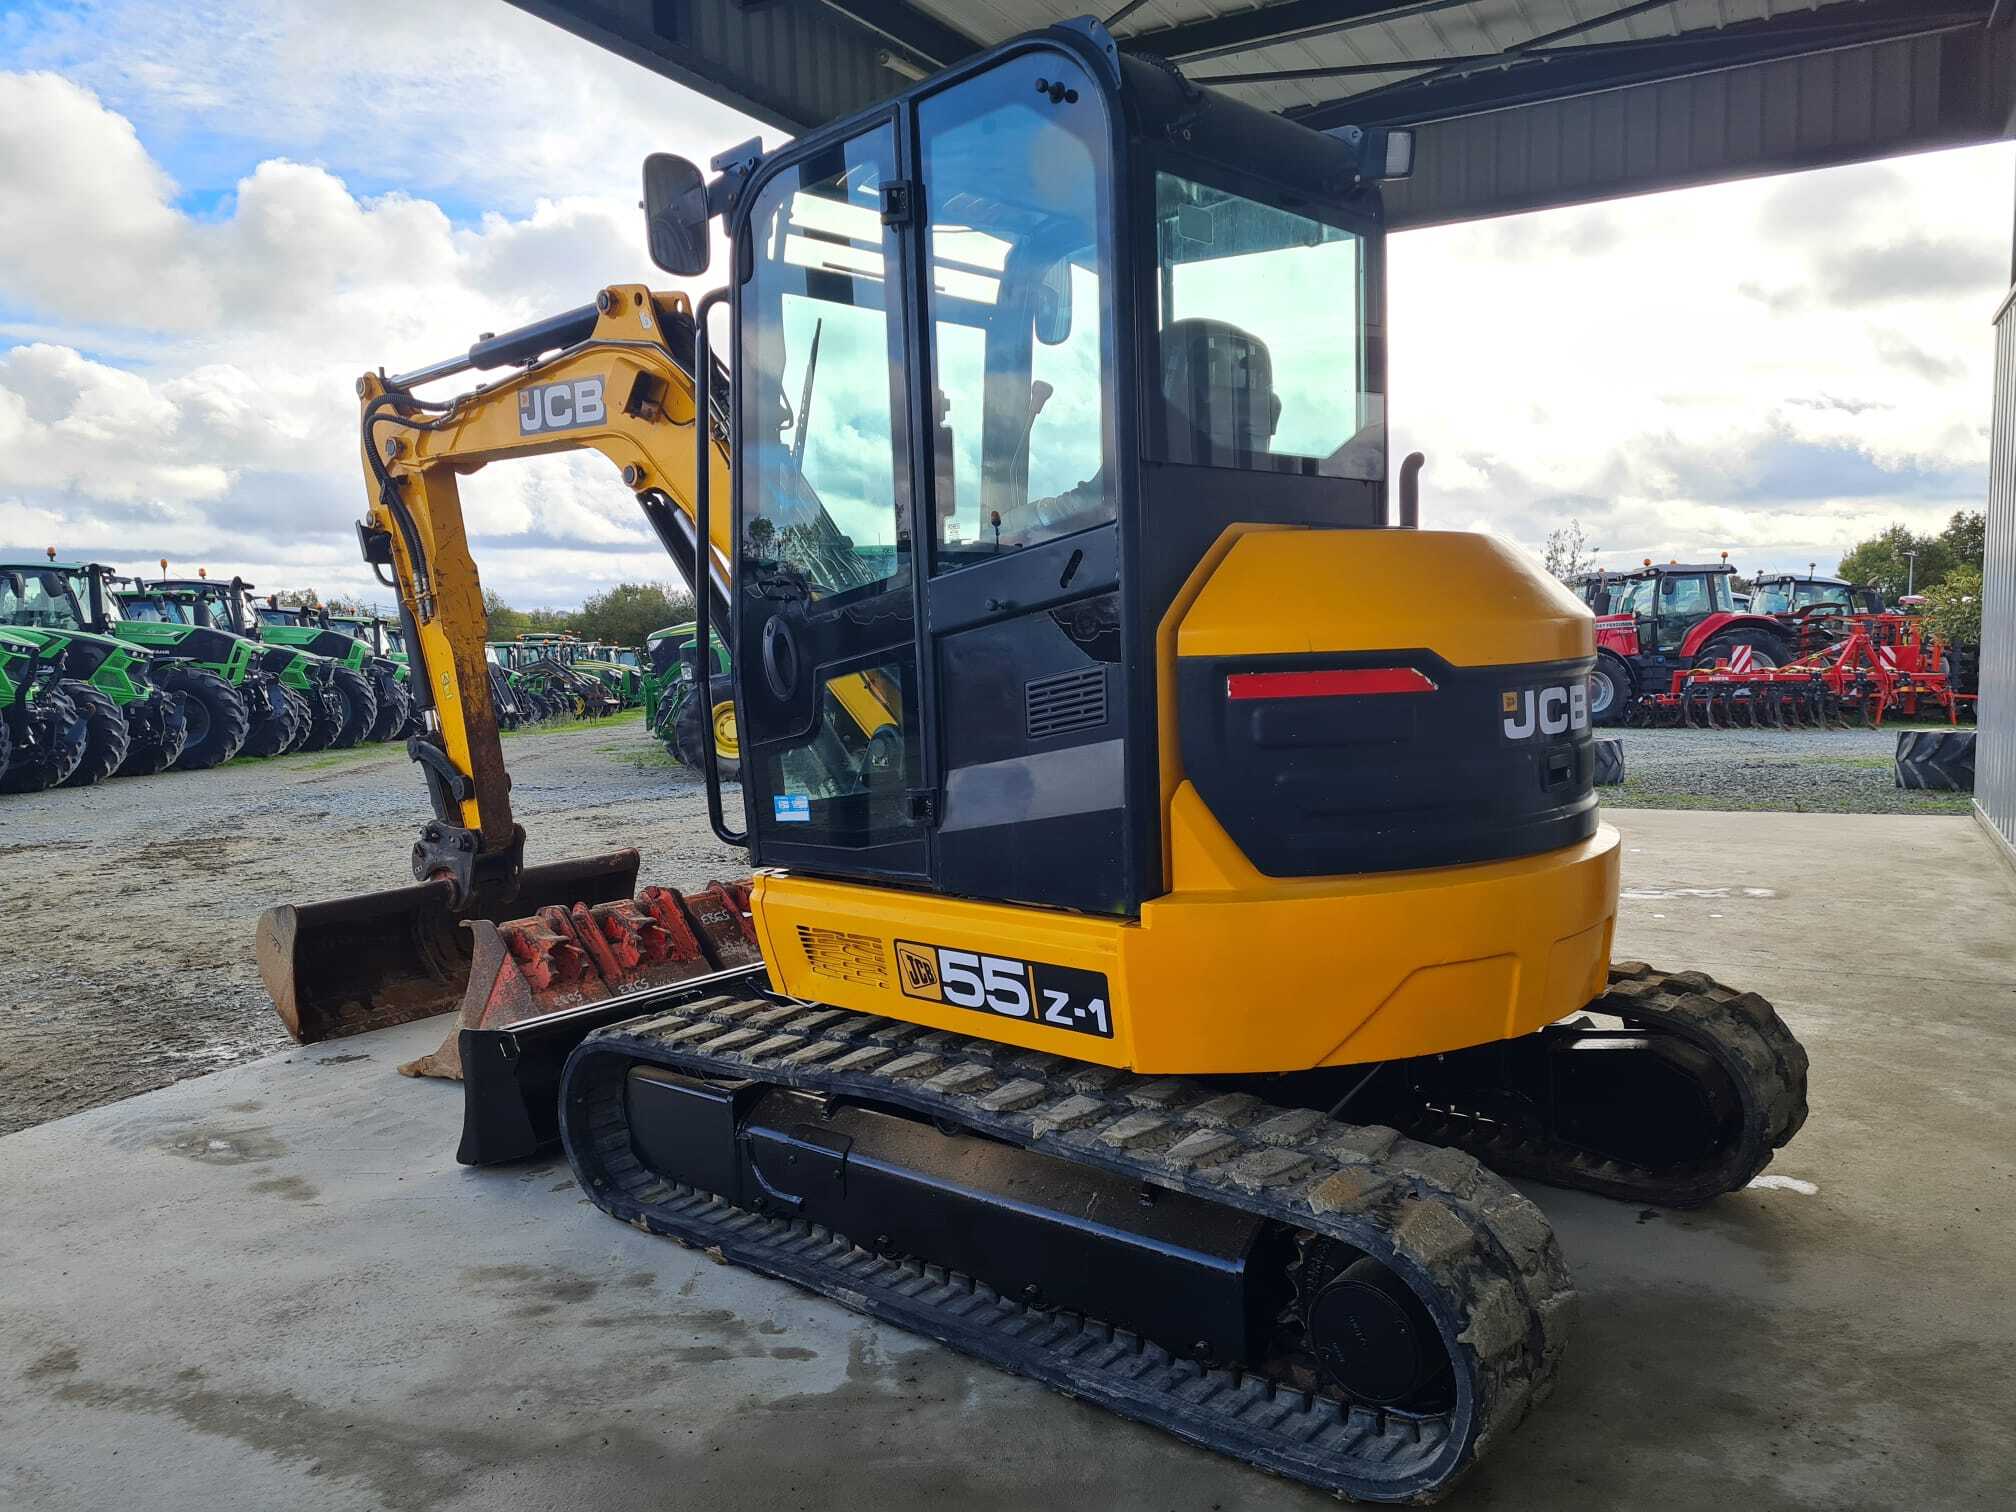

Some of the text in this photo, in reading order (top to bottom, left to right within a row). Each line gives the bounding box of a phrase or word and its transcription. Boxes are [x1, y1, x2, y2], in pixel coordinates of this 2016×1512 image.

[521, 380, 604, 431] JCB
[1504, 685, 1588, 740] JCB
[905, 948, 1108, 1033] JCB 55 Z-1
